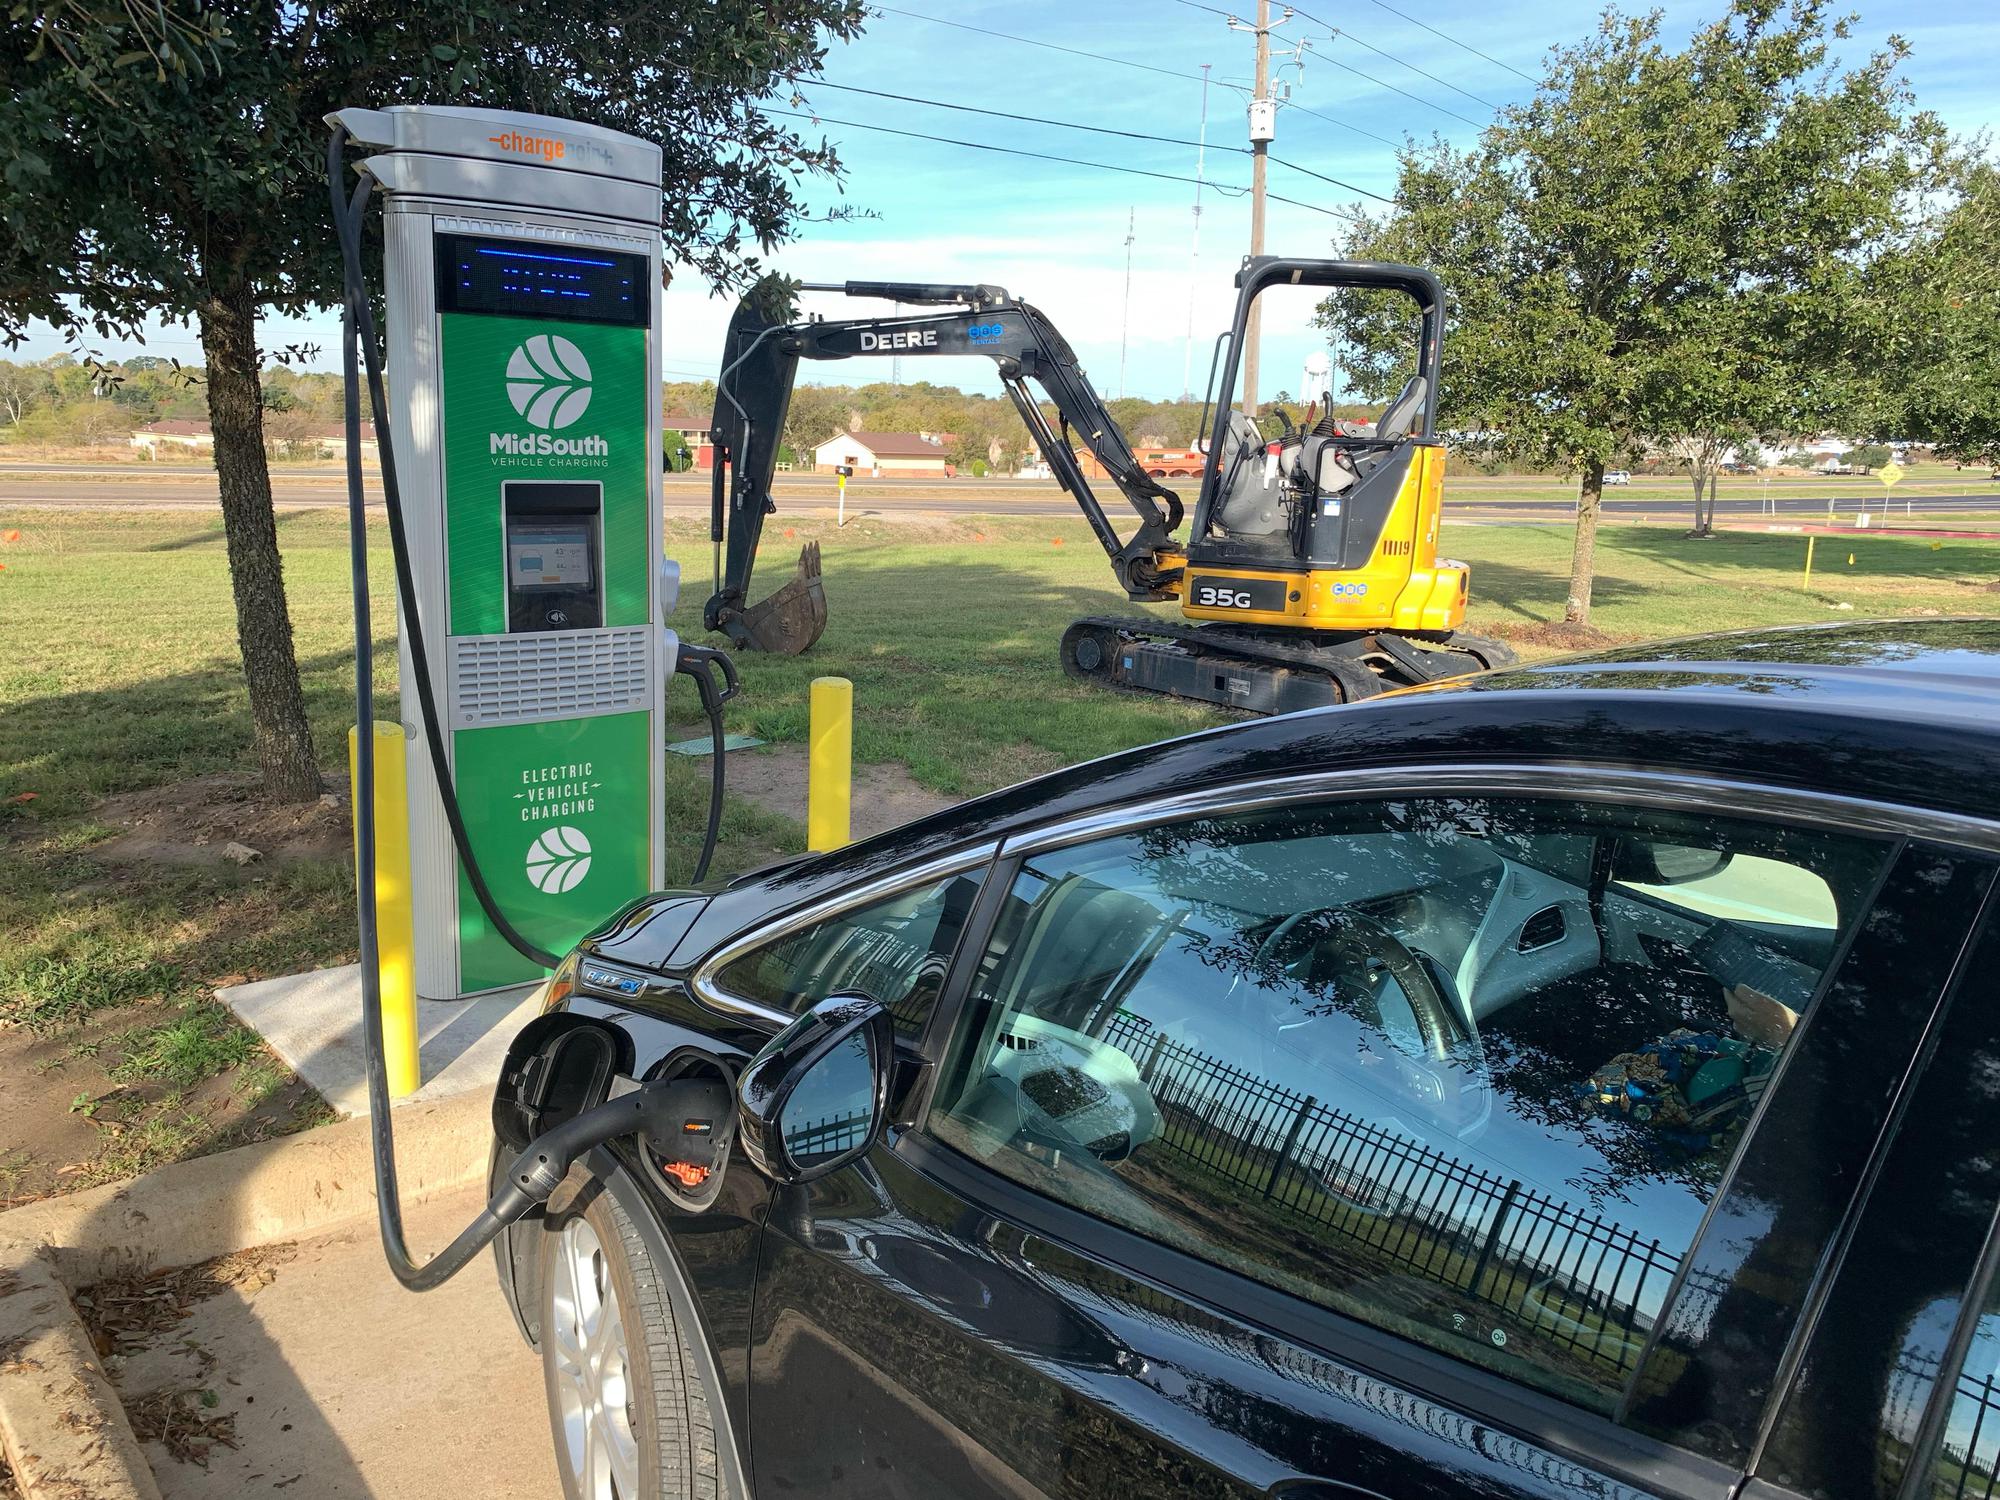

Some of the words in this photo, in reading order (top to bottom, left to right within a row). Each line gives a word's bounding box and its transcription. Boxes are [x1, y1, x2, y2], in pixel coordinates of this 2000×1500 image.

[860, 330, 938, 351] DEERE
[489, 432, 609, 456] MidSouth
[491, 457, 544, 467] VEHICLE
[549, 458, 609, 468] CHARGING
[1199, 587, 1251, 609] 35G
[523, 762, 592, 784] ELECTRIC
[528, 781, 588, 802] VEHICLE
[521, 798, 595, 822] CHARGING
